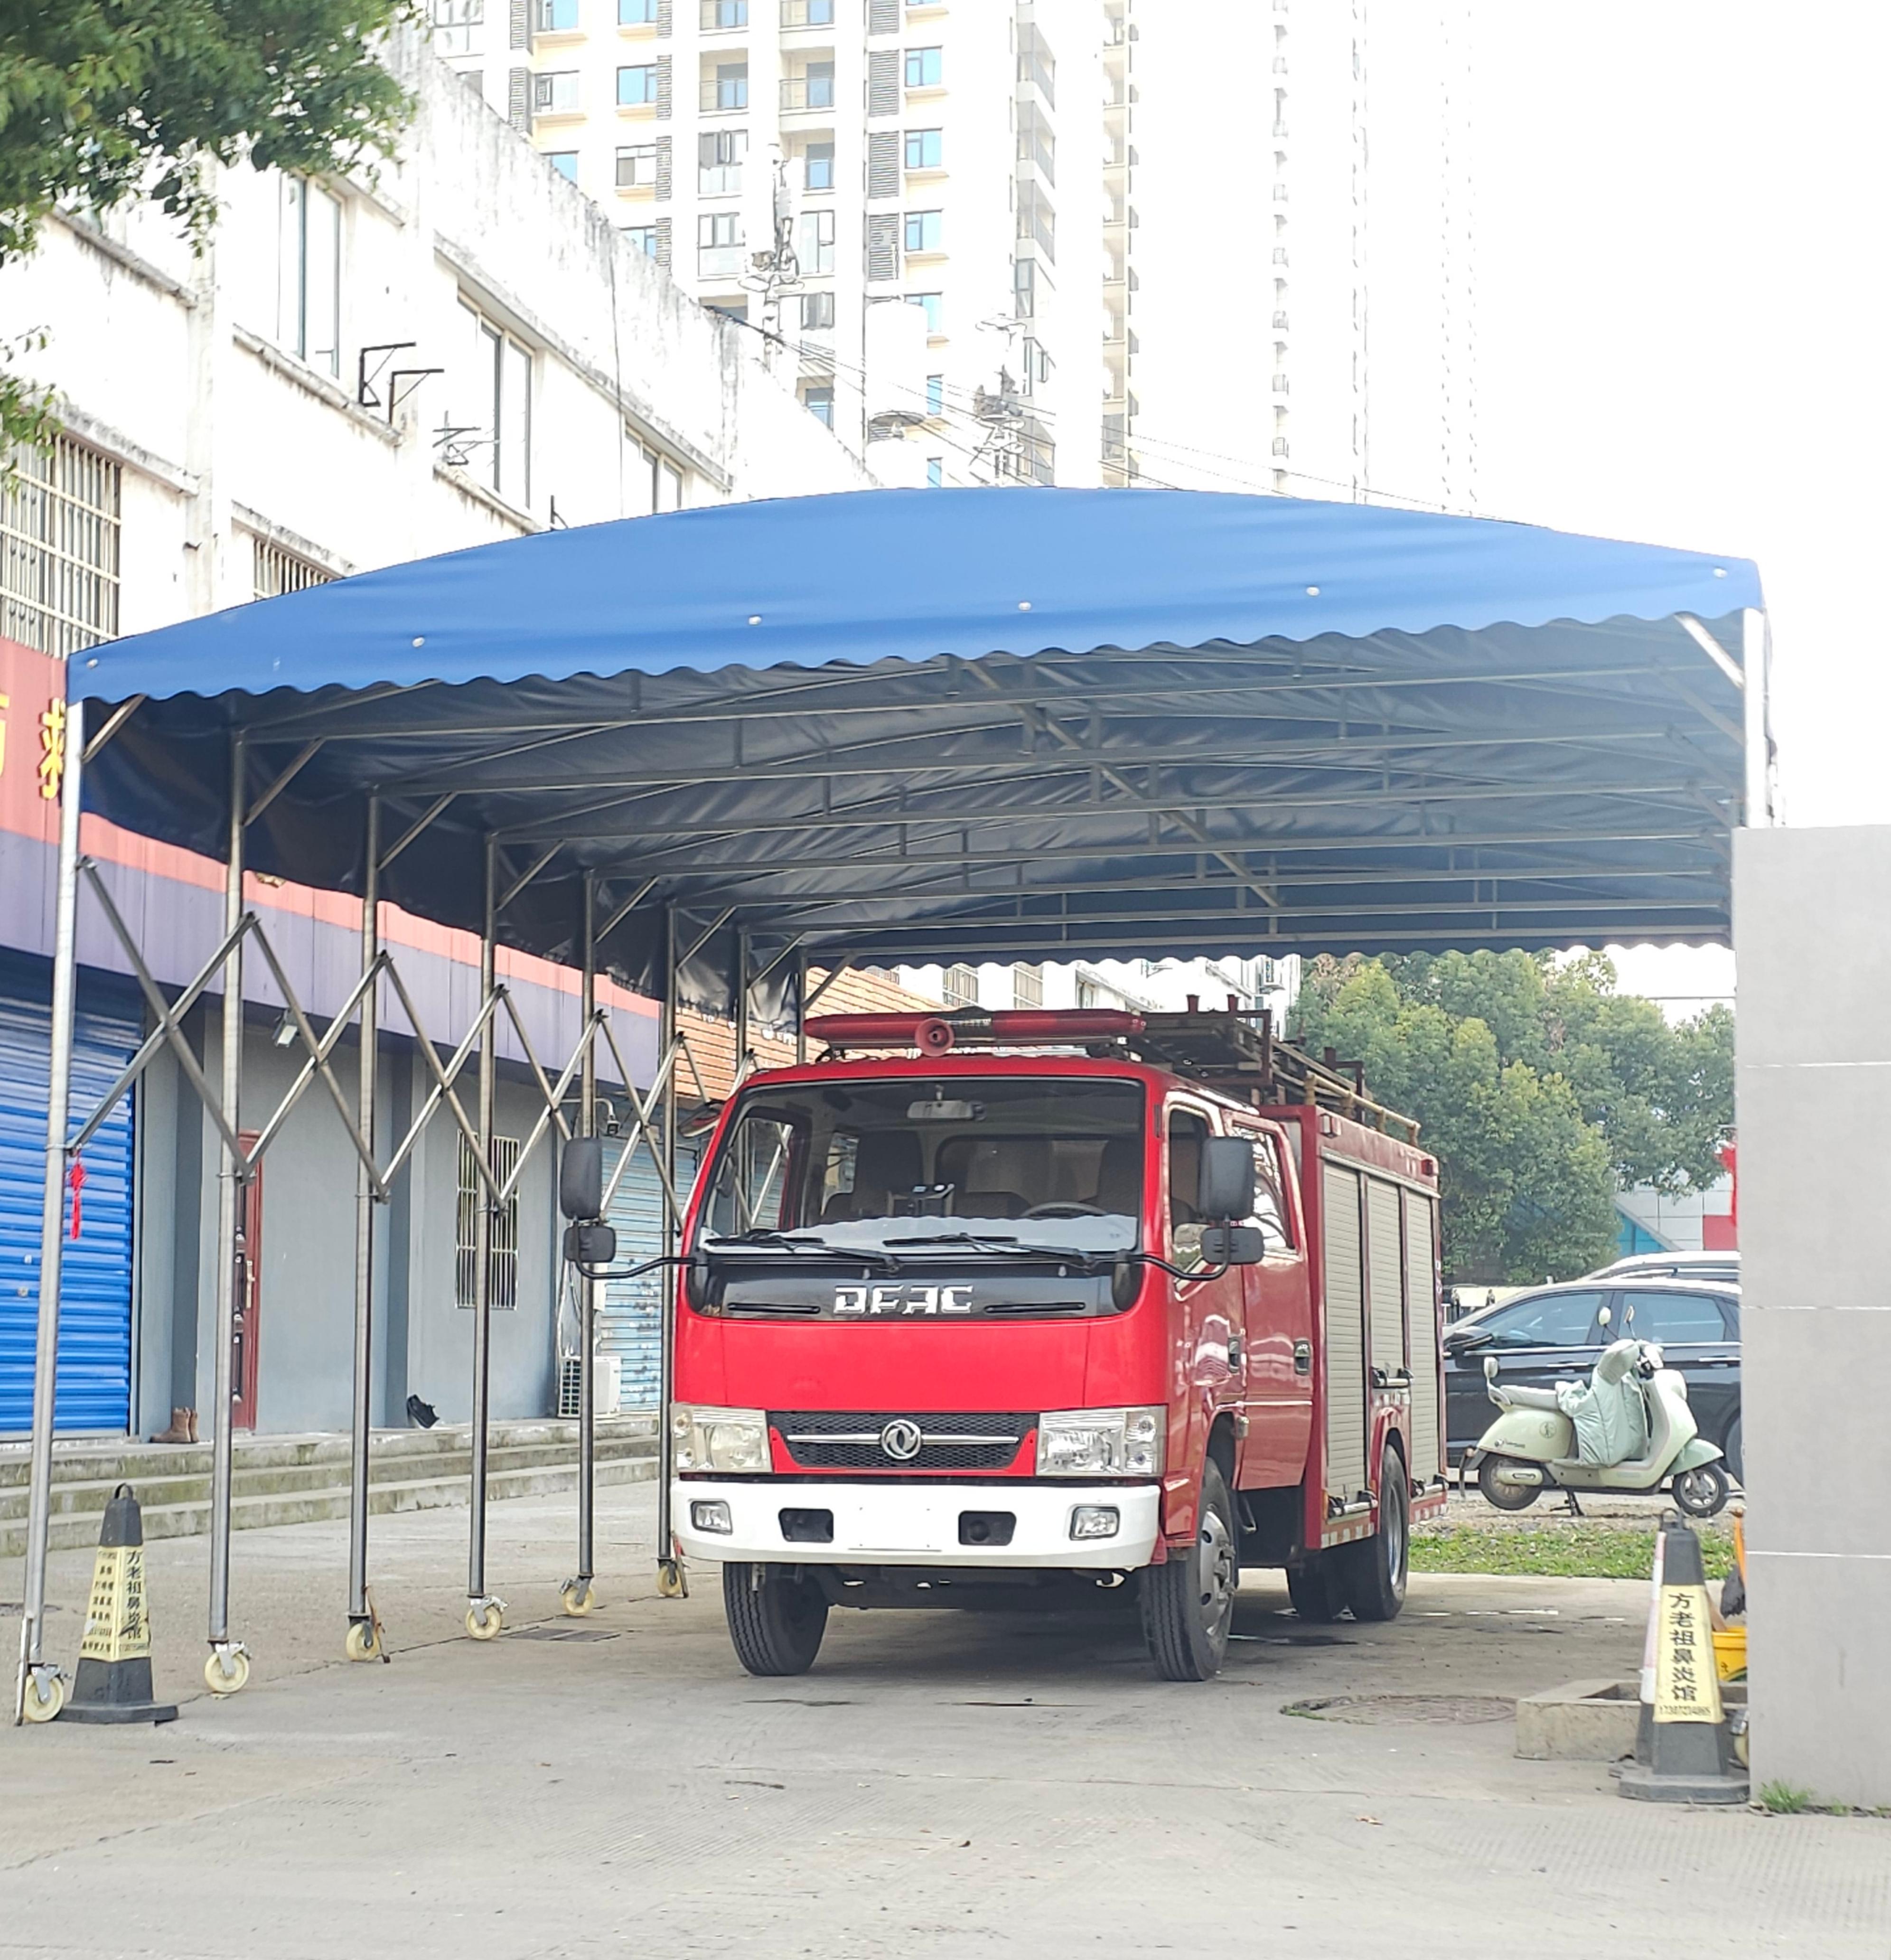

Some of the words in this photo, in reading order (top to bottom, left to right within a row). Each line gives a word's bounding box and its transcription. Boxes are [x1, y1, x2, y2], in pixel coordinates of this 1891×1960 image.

[833, 1285, 973, 1314] DFAC
[1668, 1593, 1697, 1701] 方老祖鼻炎馆
